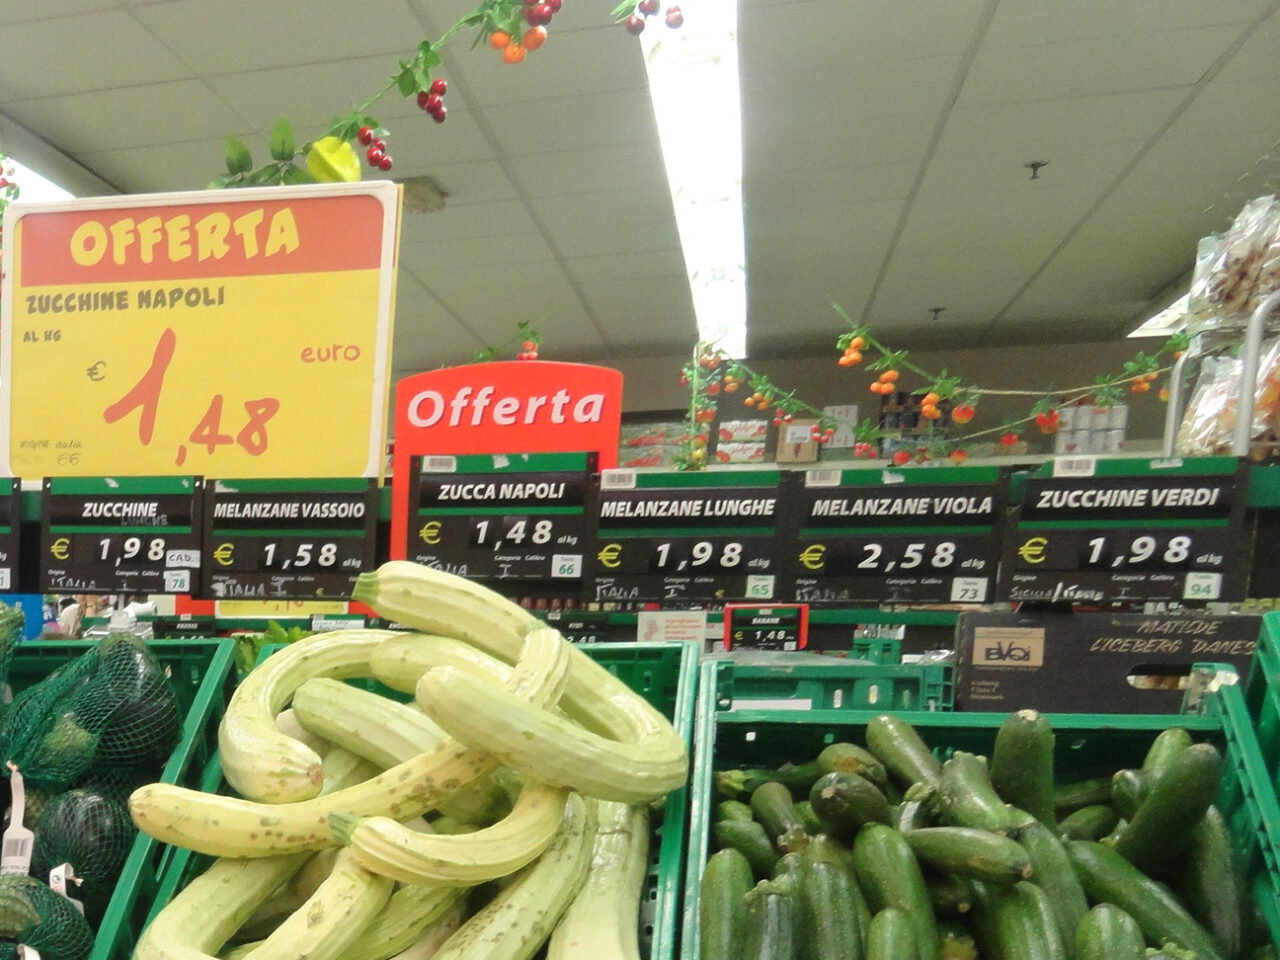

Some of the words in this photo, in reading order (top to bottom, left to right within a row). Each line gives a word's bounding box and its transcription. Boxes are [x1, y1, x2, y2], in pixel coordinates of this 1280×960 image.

[69, 206, 301, 268] OFFERTA
[24, 289, 131, 315] ZUCCHINE
[136, 285, 226, 309] NAPOLI
[22, 330, 40, 343] AL
[43, 329, 62, 343] KG
[300, 343, 362, 363] euro
[85, 360, 108, 382] €
[102, 326, 281, 467] 1,48
[407, 385, 605, 428] Offerta
[437, 484, 497, 500] ZUCCA
[499, 482, 566, 500] NAPOLI
[1036, 488, 1149, 509] ZUCCHINE
[1151, 487, 1220, 508] VERDI
[81, 502, 159, 518] ZUCCHINE
[213, 502, 299, 518] MELANZANE
[302, 501, 366, 518] VASSOIO
[600, 500, 702, 518] MELANZANE
[704, 498, 777, 517] LUNGHE
[812, 498, 931, 517] MELANZANE
[932, 496, 994, 515] VIOLA
[419, 520, 442, 545] €
[475, 519, 554, 551] 1,48
[50, 537, 70, 560] €
[99, 536, 166, 567] 1,98
[213, 542, 235, 566] €
[263, 542, 338, 570] 1,58
[597, 543, 622, 568] €
[656, 541, 743, 571] 1,98
[798, 543, 827, 570] €
[857, 541, 957, 573] 2,58
[1018, 536, 1049, 564] €
[1088, 535, 1192, 567] 1,98
[558, 563, 574, 575] 66
[171, 578, 185, 589] 78
[751, 584, 769, 596] 65
[959, 587, 979, 600] 73
[1190, 583, 1212, 596] 94
